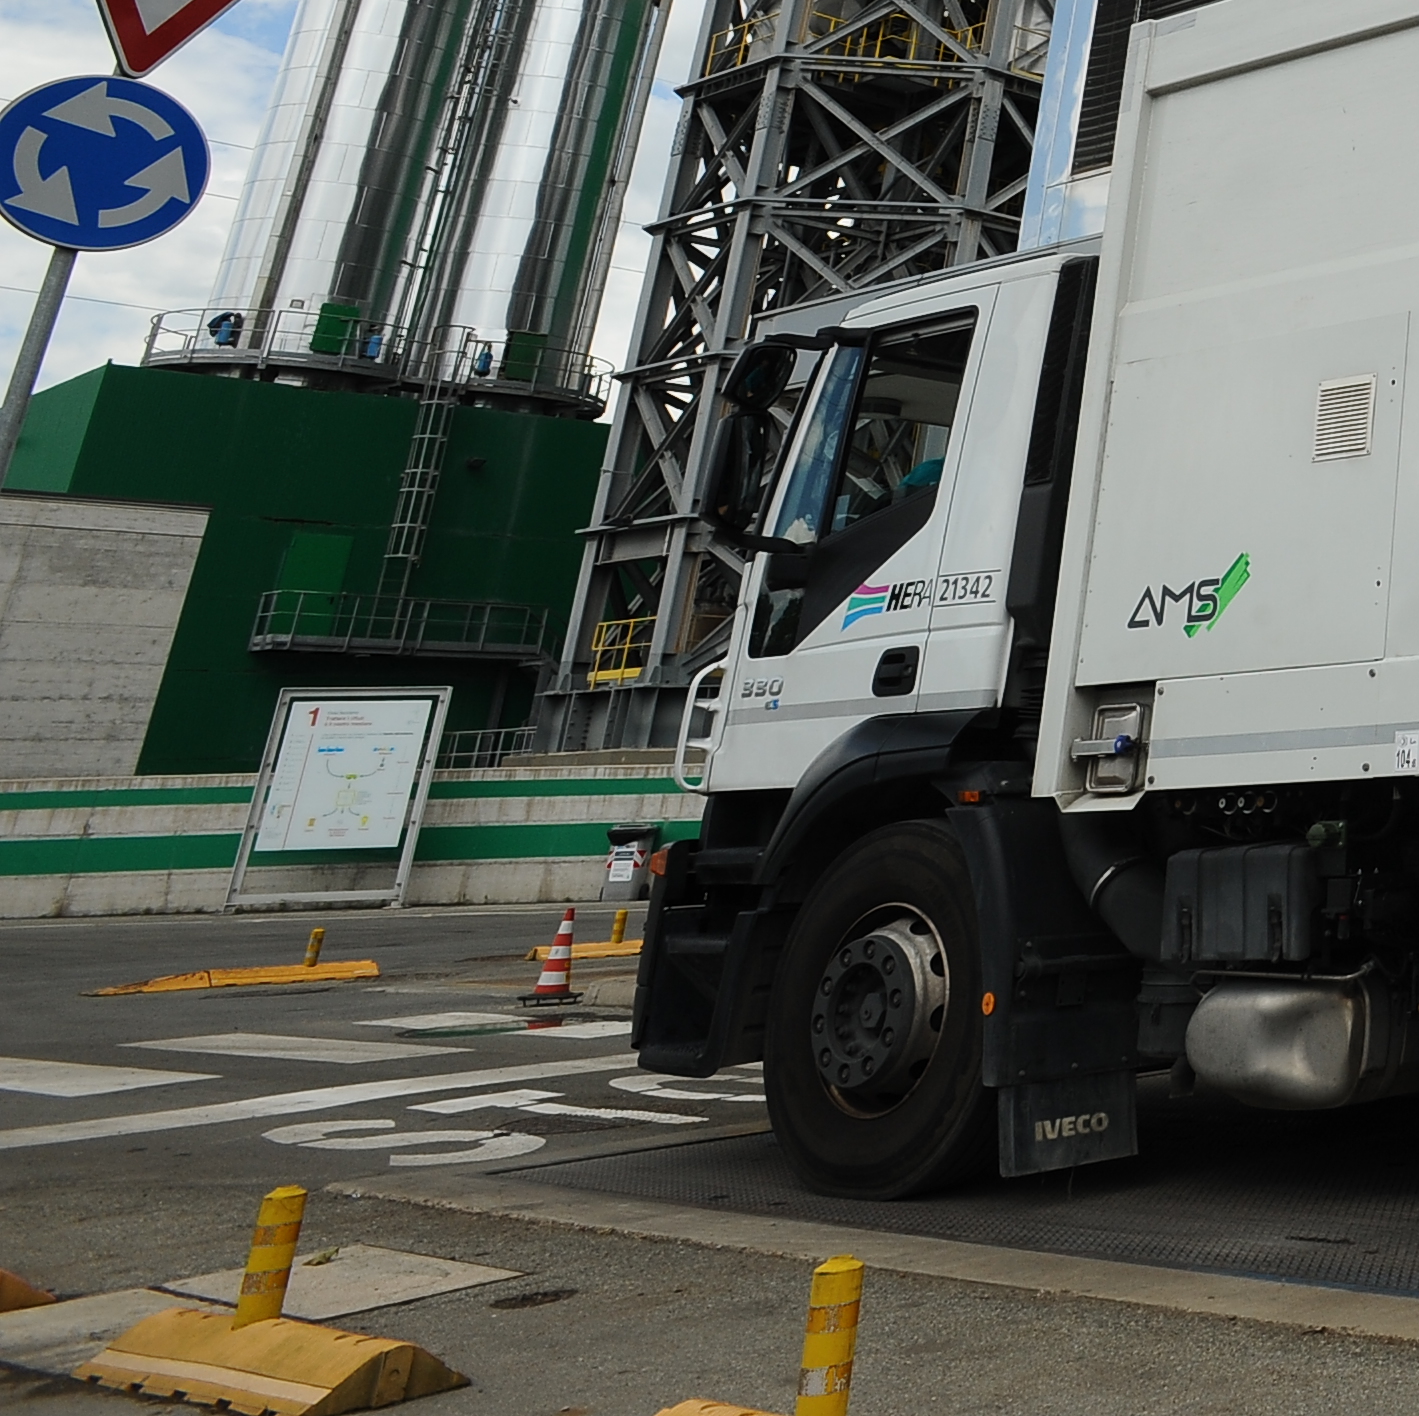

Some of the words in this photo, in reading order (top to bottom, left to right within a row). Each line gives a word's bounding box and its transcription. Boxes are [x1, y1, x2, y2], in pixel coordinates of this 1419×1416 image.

[886, 578, 933, 612] HERA
[939, 574, 993, 602] 21342
[1127, 578, 1219, 629] AMS
[741, 677, 784, 699] 330
[308, 707, 320, 727] 1
[1035, 1112, 1109, 1142] IVECO
